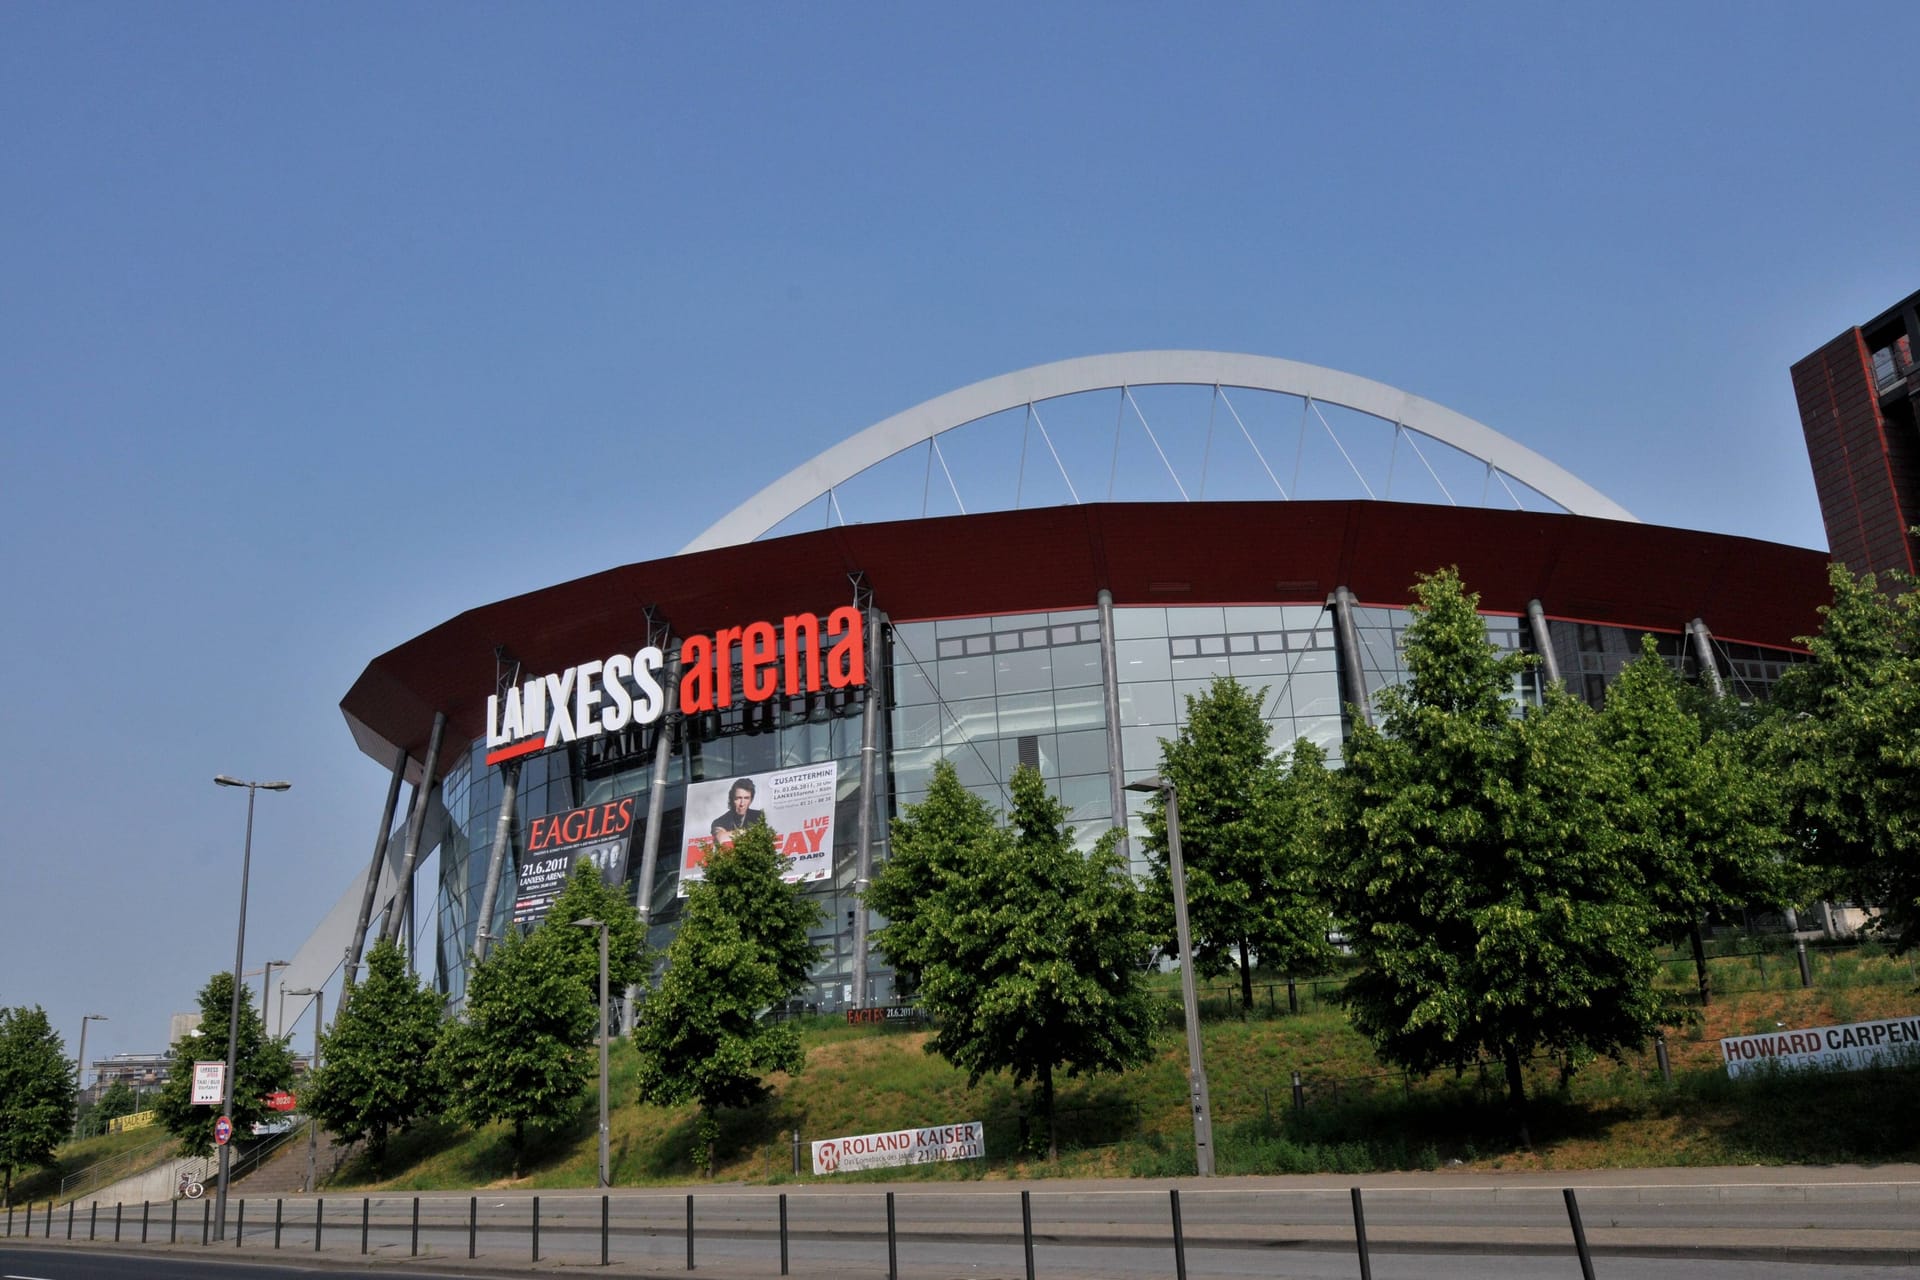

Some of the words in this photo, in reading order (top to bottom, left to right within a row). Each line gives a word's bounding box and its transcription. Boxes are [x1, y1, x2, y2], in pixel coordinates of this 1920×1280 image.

[486, 646, 664, 749] LANXESS
[680, 606, 866, 715] arena
[774, 769, 833, 785] ZUSATZTERMIN!
[528, 798, 633, 851] EAGLES
[803, 816, 830, 830] LIVE
[521, 856, 568, 877] 21.6.2011
[799, 852, 825, 861] BAND
[1725, 1032, 1822, 1062] HOWARD
[1825, 1020, 1920, 1050] CARPEN
[842, 1133, 911, 1156] ROLAND
[916, 1125, 975, 1147] KAISER
[917, 1143, 978, 1162] 21.10.2011
